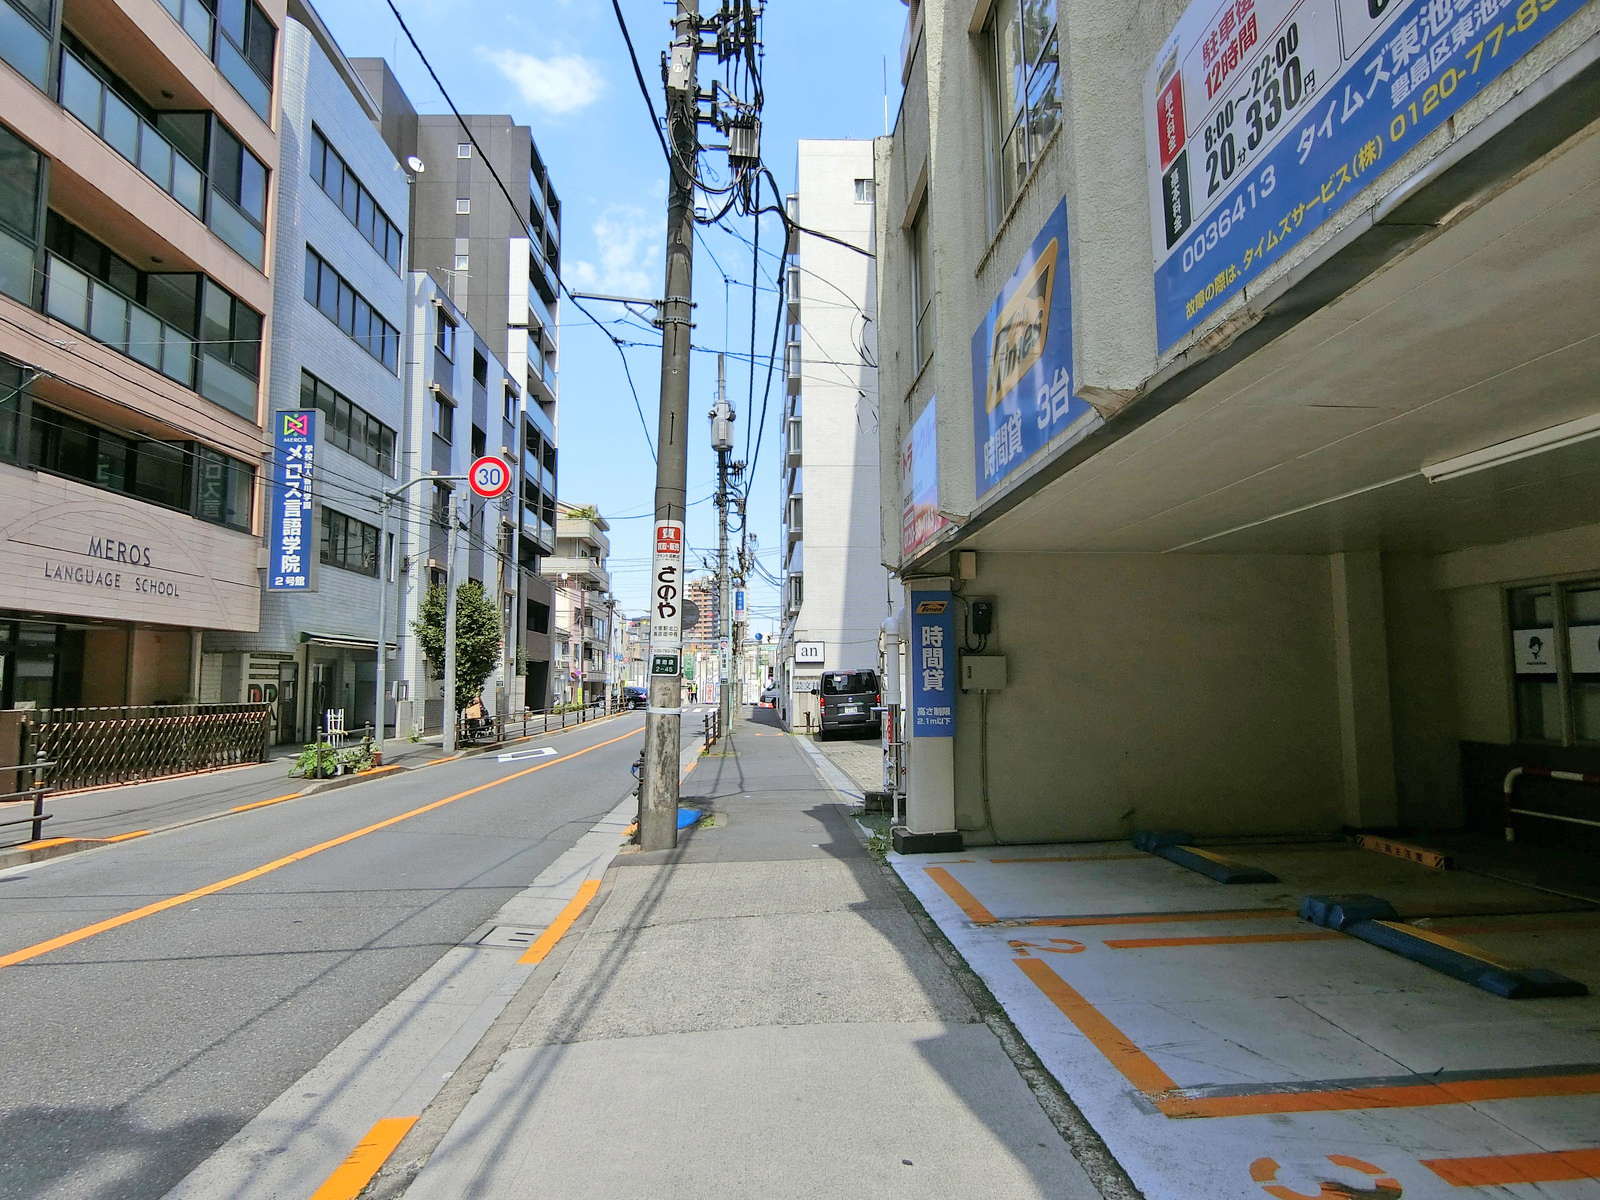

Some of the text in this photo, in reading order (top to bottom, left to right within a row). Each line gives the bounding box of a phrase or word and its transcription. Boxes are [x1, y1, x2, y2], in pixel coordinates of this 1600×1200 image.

[1204, 12, 1258, 101] 12時間
[1390, 0, 1512, 109] 豊島区東池
[1390, 0, 1560, 143] 0120-77-8
[1182, 164, 1276, 273] 0036413
[983, 366, 1070, 480] 時間貸 3台
[479, 468, 500, 486] 30
[280, 444, 303, 574] メロス言語学院
[87, 536, 151, 567] MEROS
[44, 562, 180, 597] LANGUAGE SCHOOL
[275, 575, 306, 587] 2号館
[657, 566, 677, 619] さのや
[801, 646, 818, 657] an
[921, 625, 945, 692] 時間貸
[917, 706, 951, 717] 高さ制限
[917, 717, 951, 726] 2.1m以下
